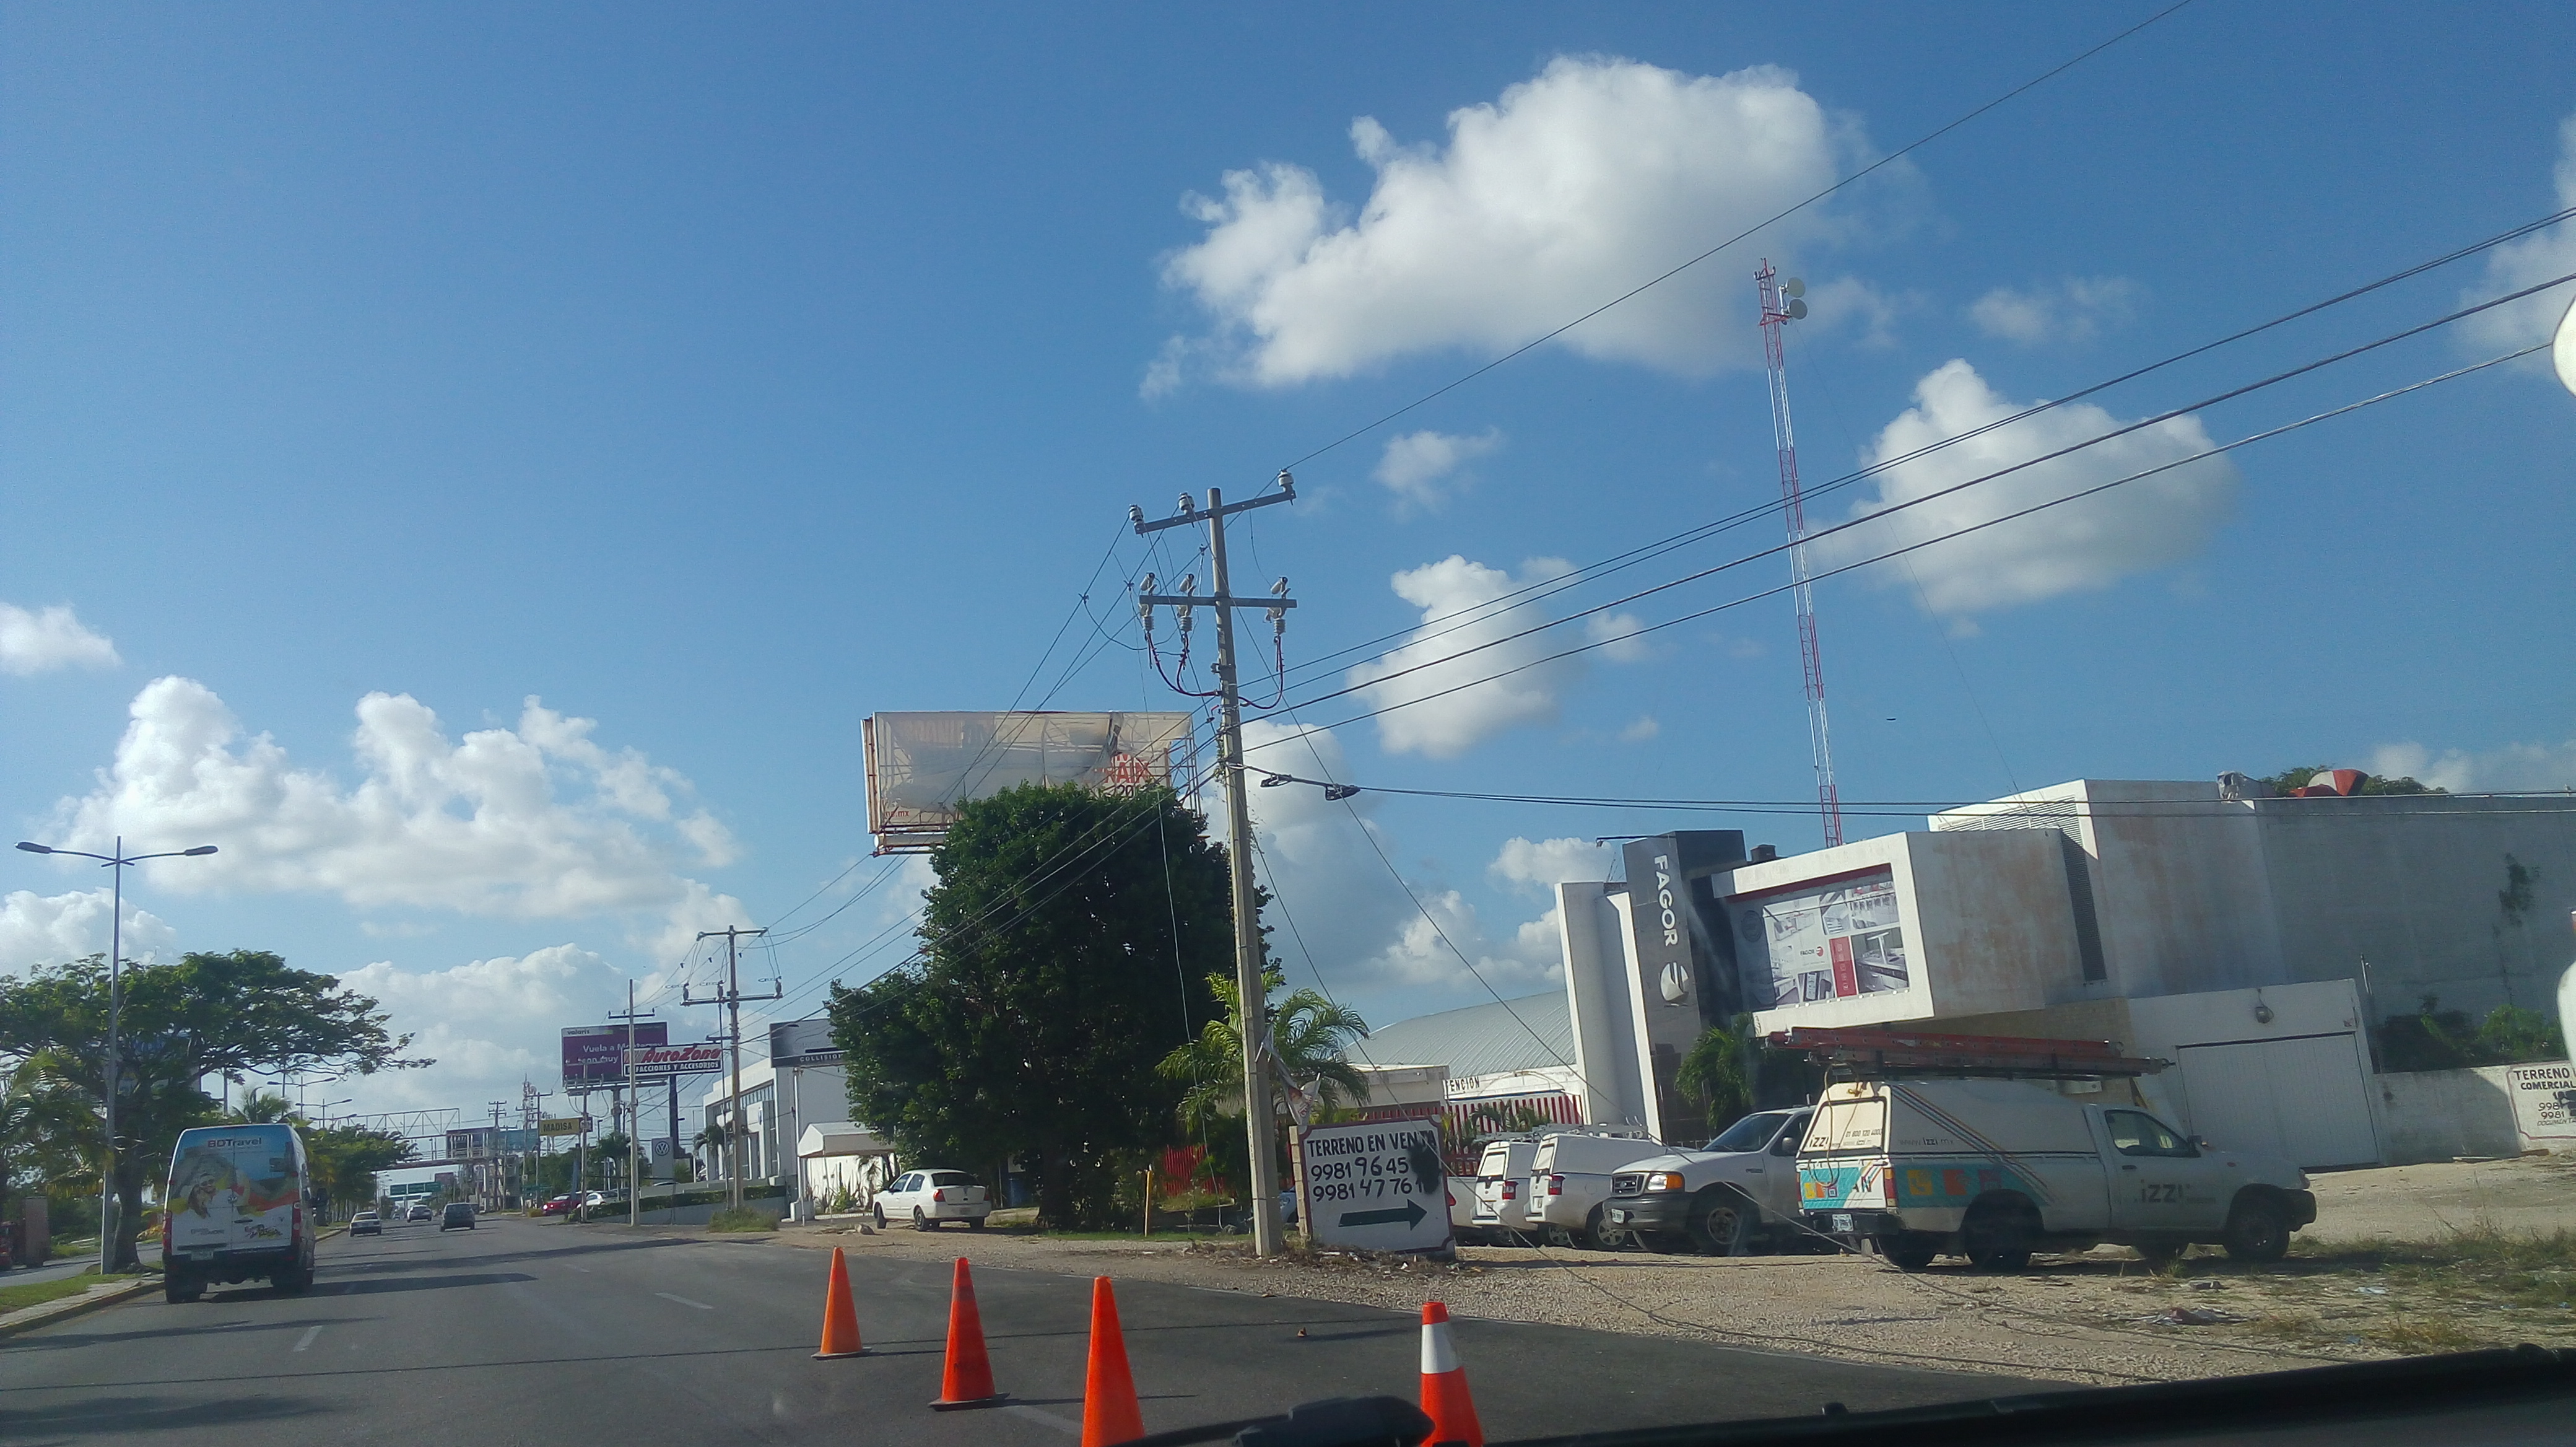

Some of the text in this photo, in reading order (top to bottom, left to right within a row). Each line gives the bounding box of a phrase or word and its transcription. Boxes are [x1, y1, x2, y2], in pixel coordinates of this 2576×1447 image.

[1654, 855, 1678, 946] FAGOR
[583, 1044, 607, 1052] Vuela
[641, 1047, 721, 1064] AutoZone
[681, 1061, 718, 1070] ACCESORIOS
[2513, 1067, 2570, 1080] TERRENO
[2520, 1081, 2576, 1090] COMERCIAL
[2541, 1111, 2564, 1119] 9981
[543, 1122, 572, 1132] MADISA
[207, 1137, 262, 1147] BDTravel
[1307, 1136, 1364, 1156] TERRENO
[1367, 1134, 1386, 1152] EN
[1311, 1161, 1351, 1181] 9981
[1313, 1183, 1355, 1202] 9981
